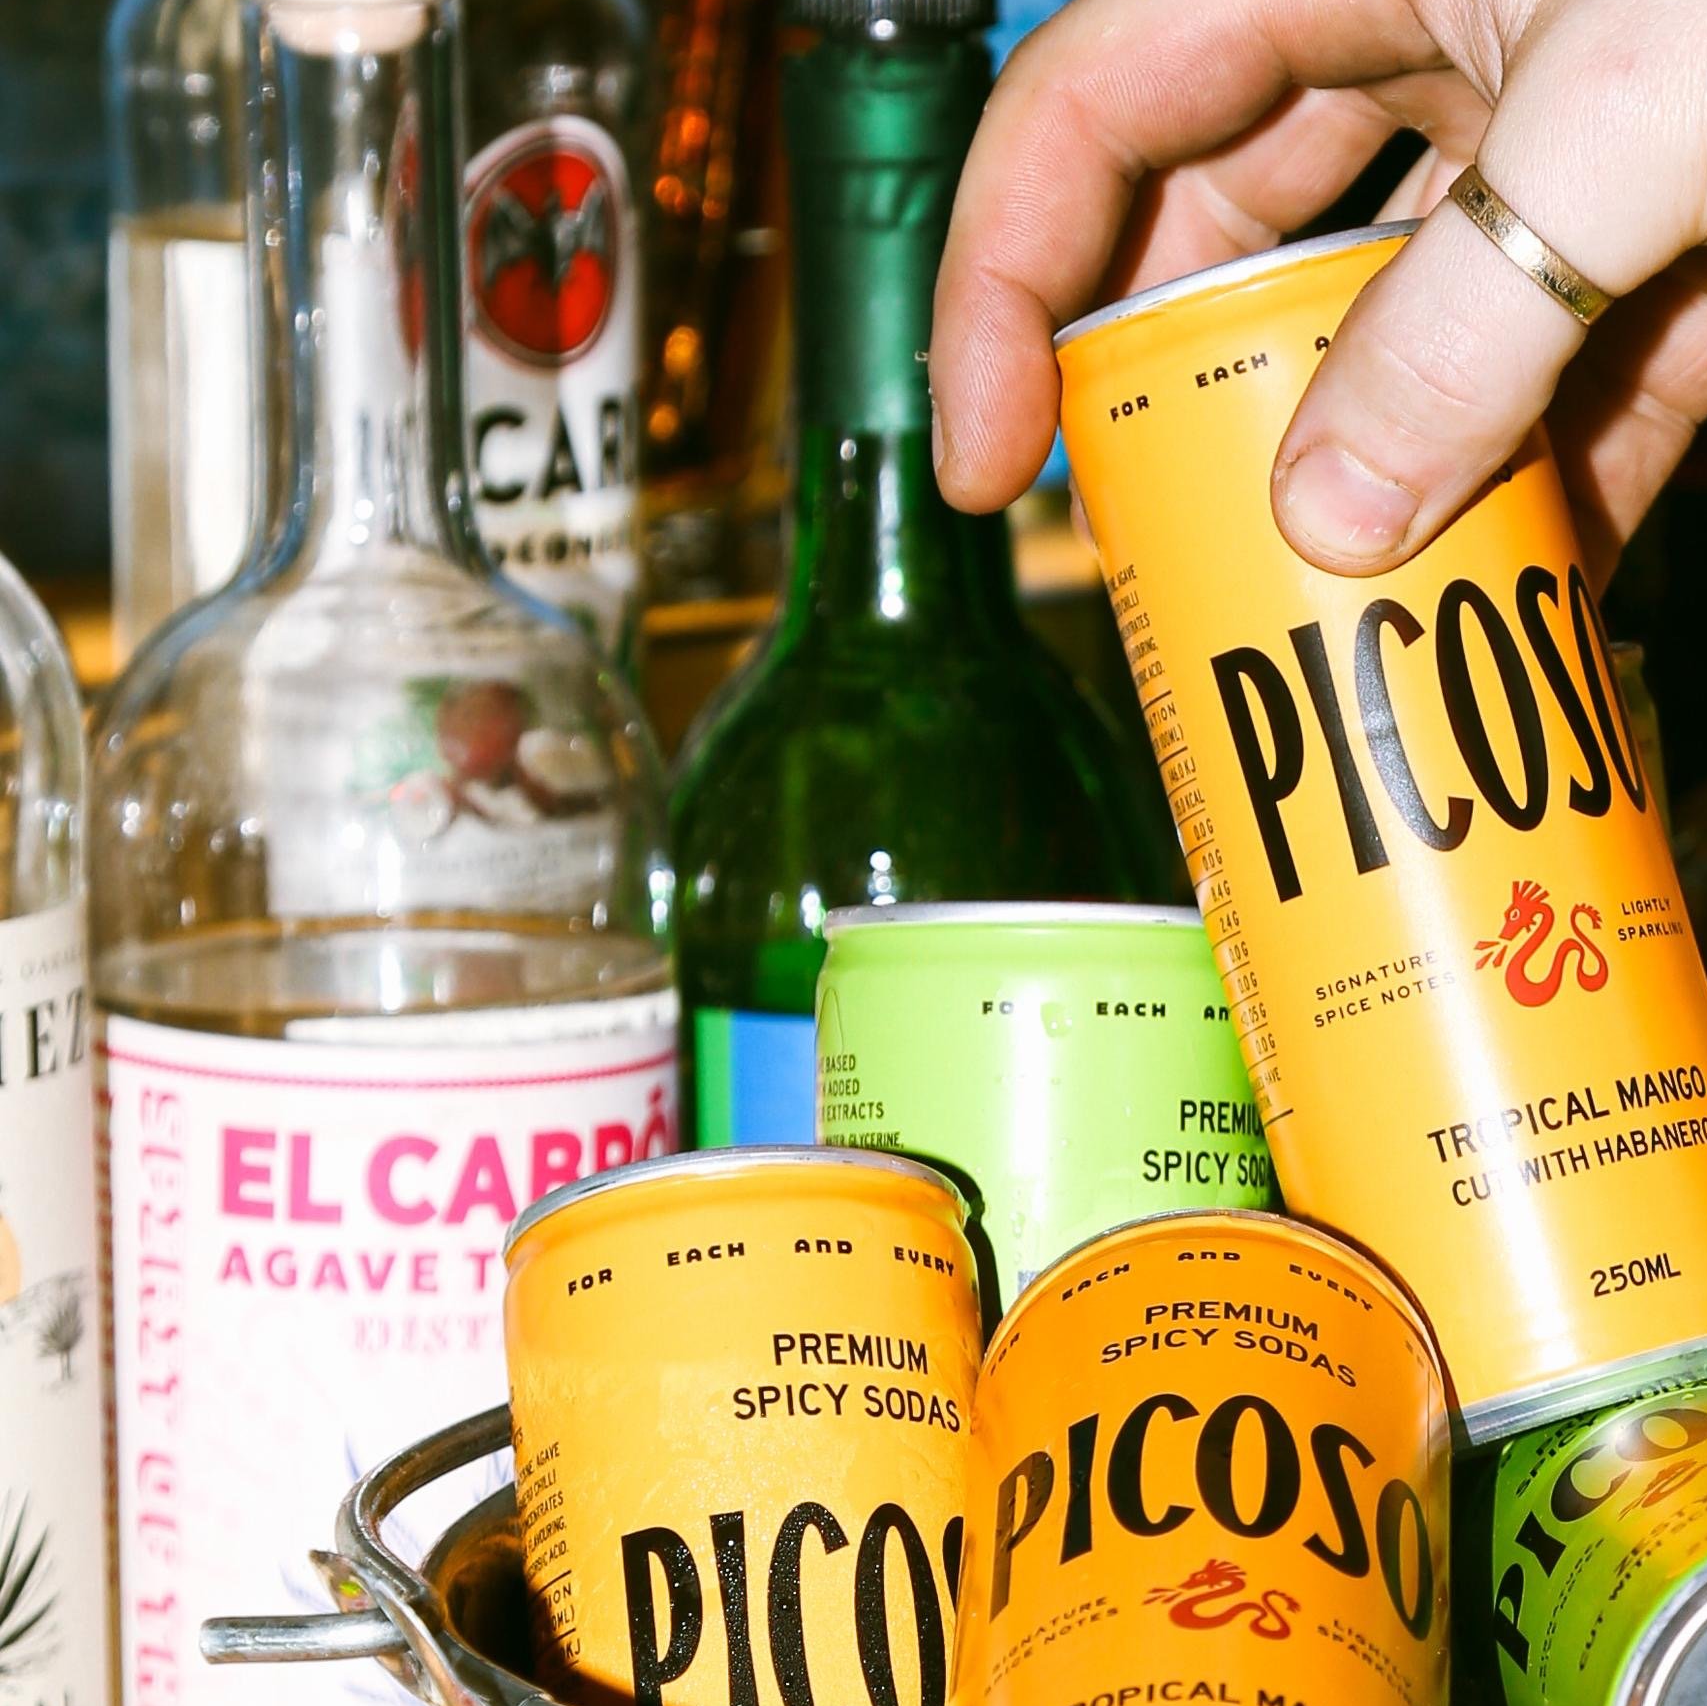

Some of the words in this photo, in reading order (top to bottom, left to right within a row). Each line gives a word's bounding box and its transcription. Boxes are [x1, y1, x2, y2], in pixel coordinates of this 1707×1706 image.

[1110, 395, 1150, 422] FOR
[1195, 352, 1269, 388] EACH
[1210, 564, 1647, 904] PICOSO
[1315, 949, 1438, 1000] SIGNATURE
[1621, 897, 1672, 916] LIGHTLY
[1096, 1001, 1167, 1017] EACH
[1203, 1006, 1230, 1021] AN
[1313, 998, 1371, 1028] SPICE
[1381, 970, 1456, 1005] NOTES
[825, 1054, 856, 1073] BASED
[826, 1078, 860, 1097] ADDED
[826, 1101, 885, 1123] EXTRACTS
[1427, 1086, 1610, 1164] TROPICAL
[1616, 1064, 1707, 1112] MANGO
[218, 1124, 343, 1225] EL
[1142, 1149, 1229, 1183] SPICY
[1452, 1169, 1503, 1207] CUT
[1519, 1140, 1591, 1187] WITH
[217, 1245, 440, 1296] AGAVE
[567, 1268, 613, 1296] FOR
[667, 1241, 745, 1267] EACH
[794, 1238, 853, 1255] AND
[893, 1246, 955, 1278] EVERY
[1061, 1263, 1131, 1302] EACH
[1177, 1250, 1241, 1262] AND
[1289, 1263, 1374, 1312] EVERY
[1590, 1253, 1681, 1297] 250ML
[1145, 1300, 1319, 1342] PREMIUM
[771, 1332, 929, 1375] PREMIUM
[1100, 1327, 1217, 1365] SPICY
[1233, 1330, 1357, 1389] SODAS
[733, 1383, 848, 1421] SPICY
[864, 1386, 961, 1433] SODAS
[988, 1393, 1433, 1642] PICOSO
[992, 1596, 1108, 1671] SIGNATURE
[1042, 1606, 1119, 1646] NOTES
